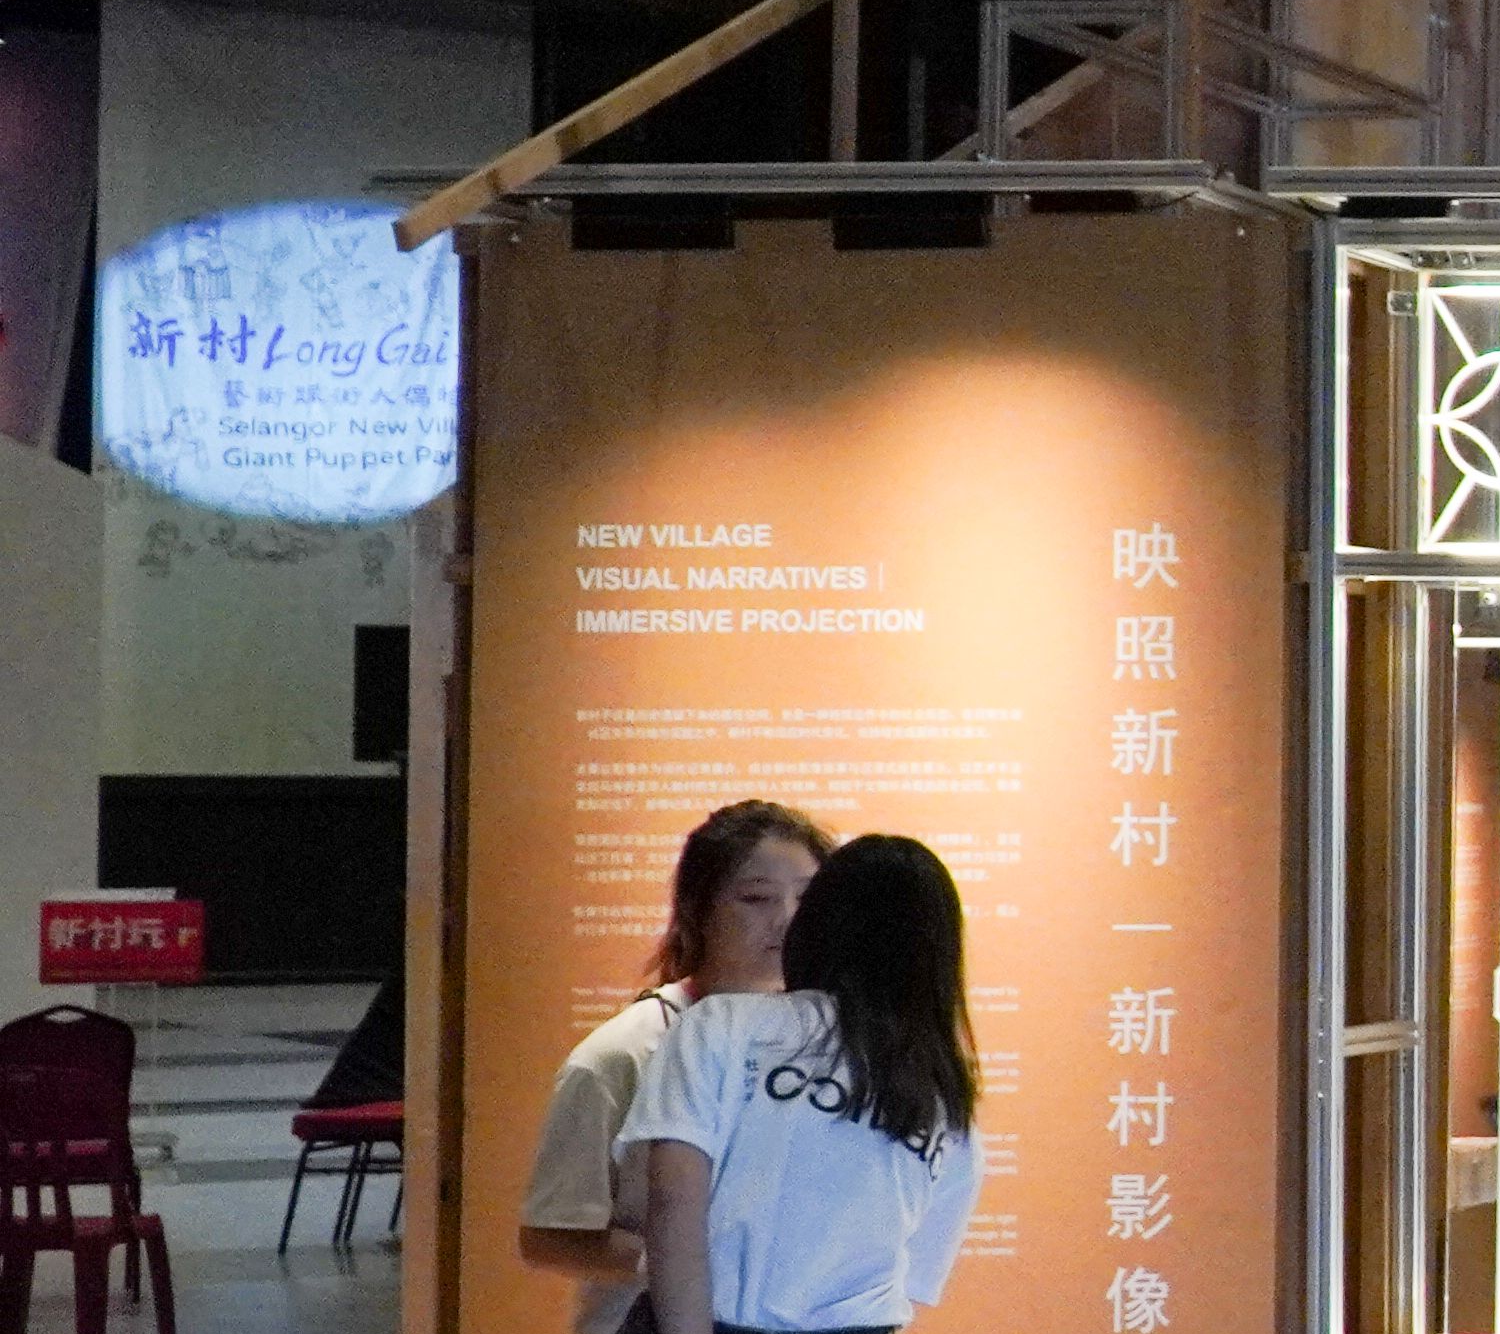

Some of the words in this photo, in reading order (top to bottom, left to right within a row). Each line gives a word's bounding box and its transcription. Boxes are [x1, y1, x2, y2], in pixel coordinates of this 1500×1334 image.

[129, 311, 255, 367] 新村
[263, 324, 366, 377] Long
[218, 417, 334, 442] Selangor
[349, 418, 407, 436] New
[416, 417, 457, 436] Vill
[223, 447, 295, 467] Giant
[306, 447, 405, 470] Puppet
[577, 524, 643, 548] NEW
[650, 524, 773, 548] VILLAGE
[576, 566, 681, 591] VISUAL
[687, 566, 867, 591] NARRATIVES
[576, 609, 734, 633] IMMERSIVE
[741, 608, 925, 633] PROJECTION
